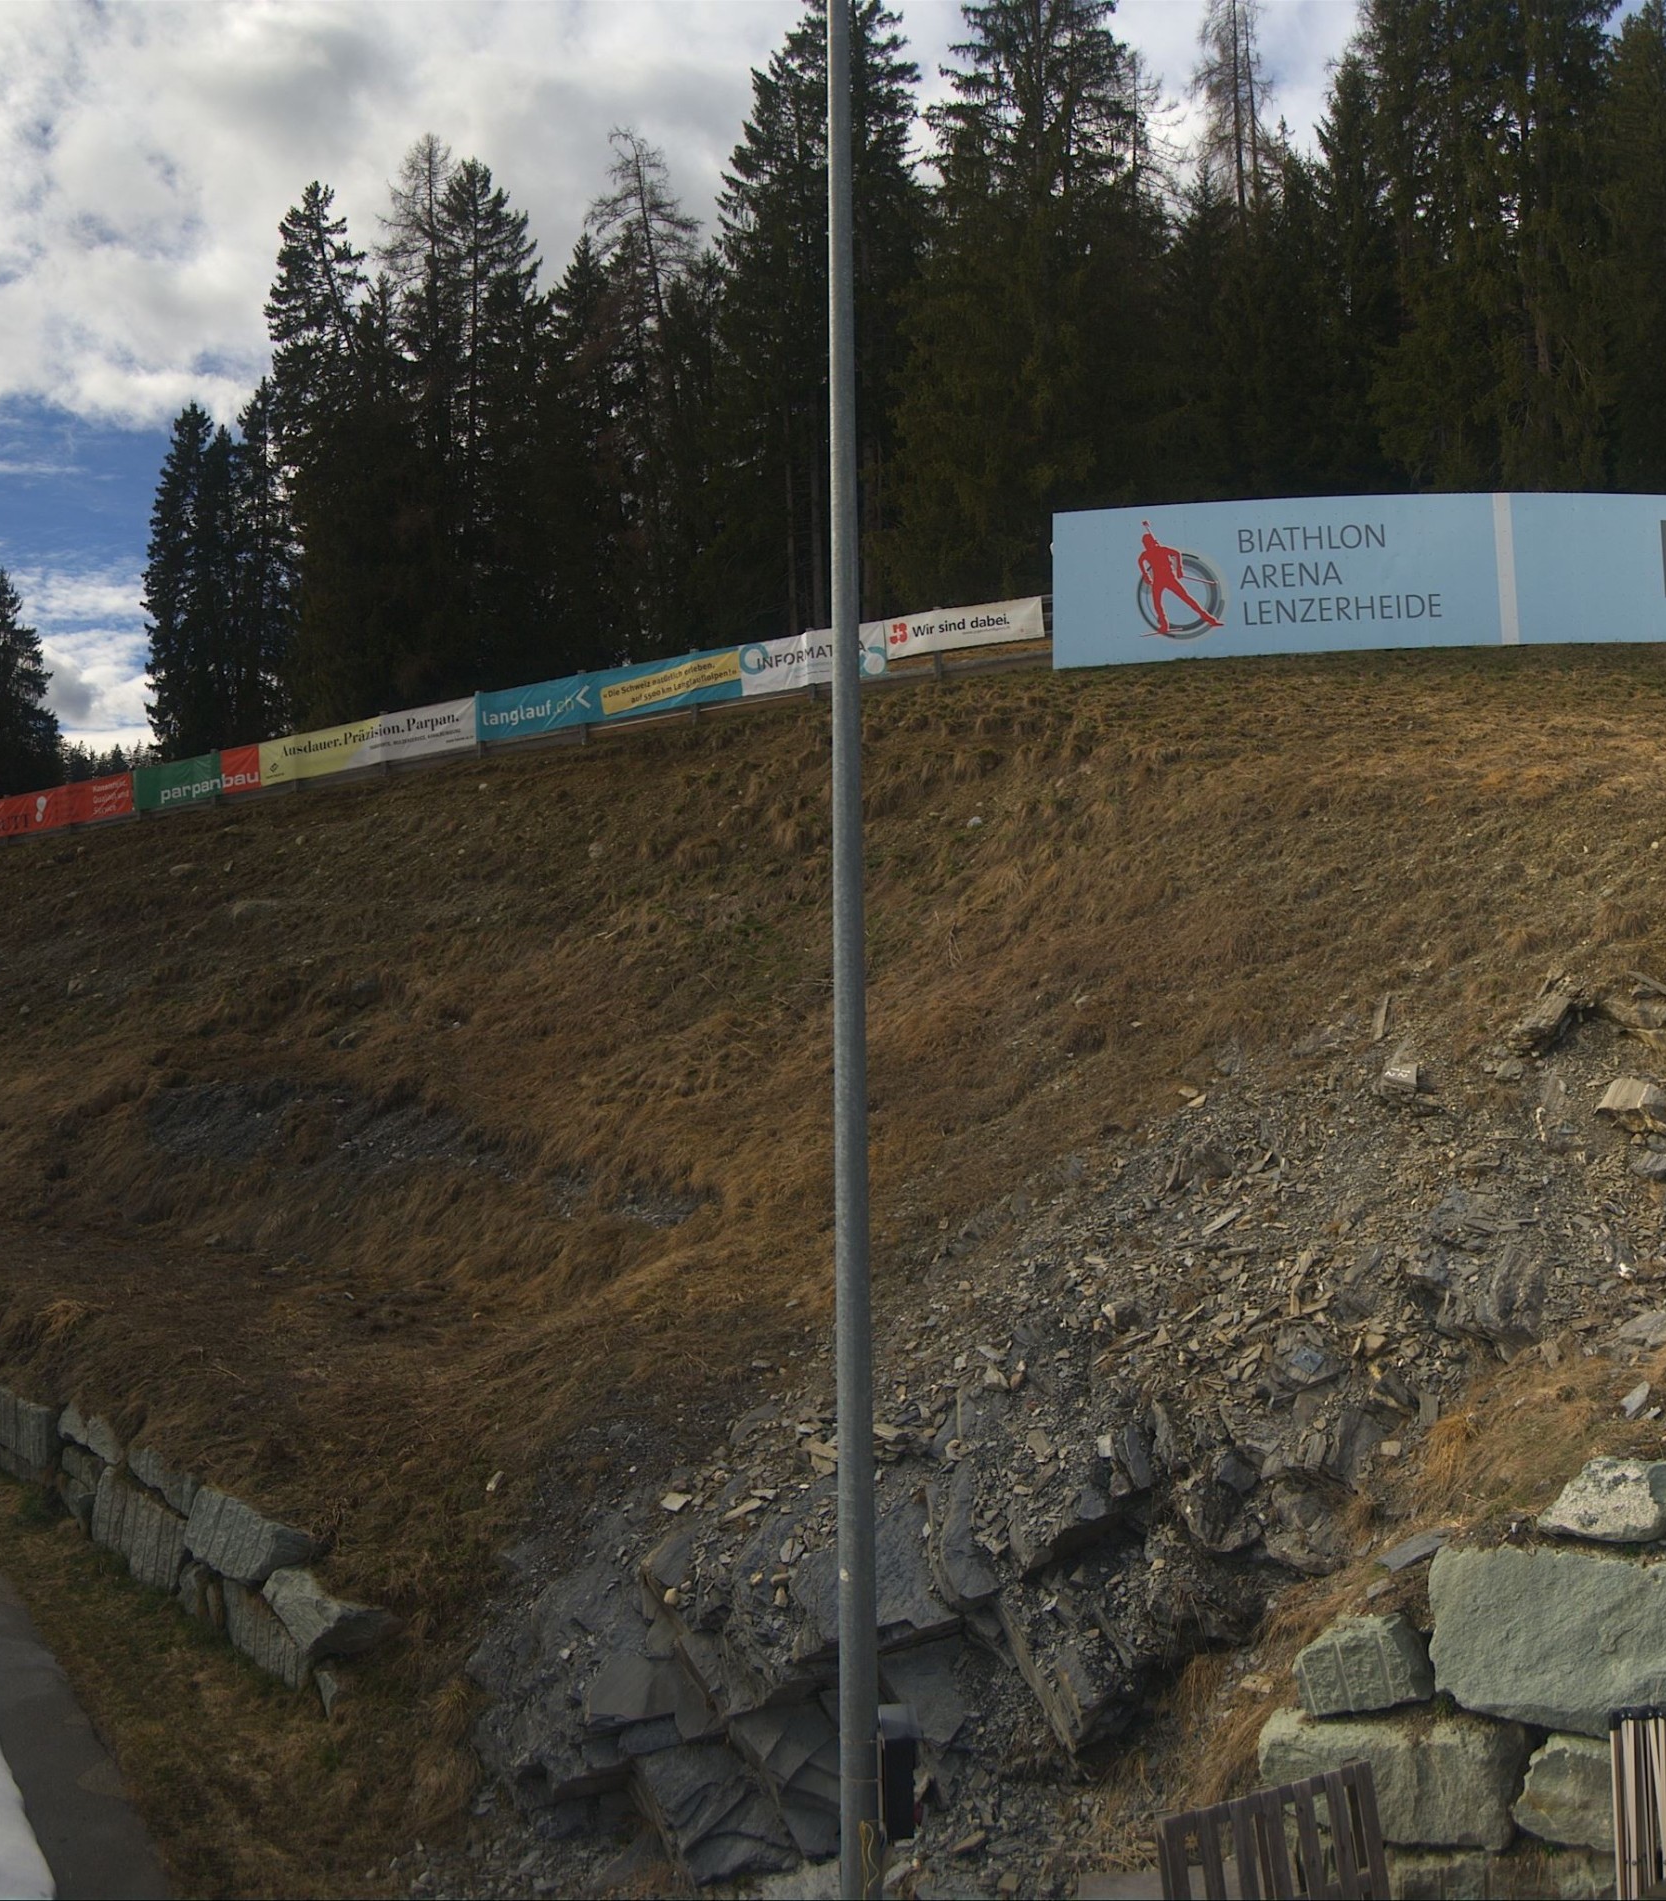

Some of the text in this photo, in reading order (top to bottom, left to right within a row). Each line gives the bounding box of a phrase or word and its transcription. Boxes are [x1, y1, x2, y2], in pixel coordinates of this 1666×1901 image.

[1238, 524, 1386, 554] BIATHLON
[1240, 561, 1343, 590] ARENA
[1243, 593, 1442, 626] LENZERHEIDE
[912, 623, 935, 638] Wir
[938, 618, 965, 634] sind
[970, 613, 1010, 629] dabei.
[757, 640, 866, 671] INFORMATA
[621, 681, 651, 695] Schweiz
[661, 686, 673, 696] km
[282, 714, 460, 757] Ausdauer. Präzision. Parpan.
[160, 771, 259, 804] parpanbau
